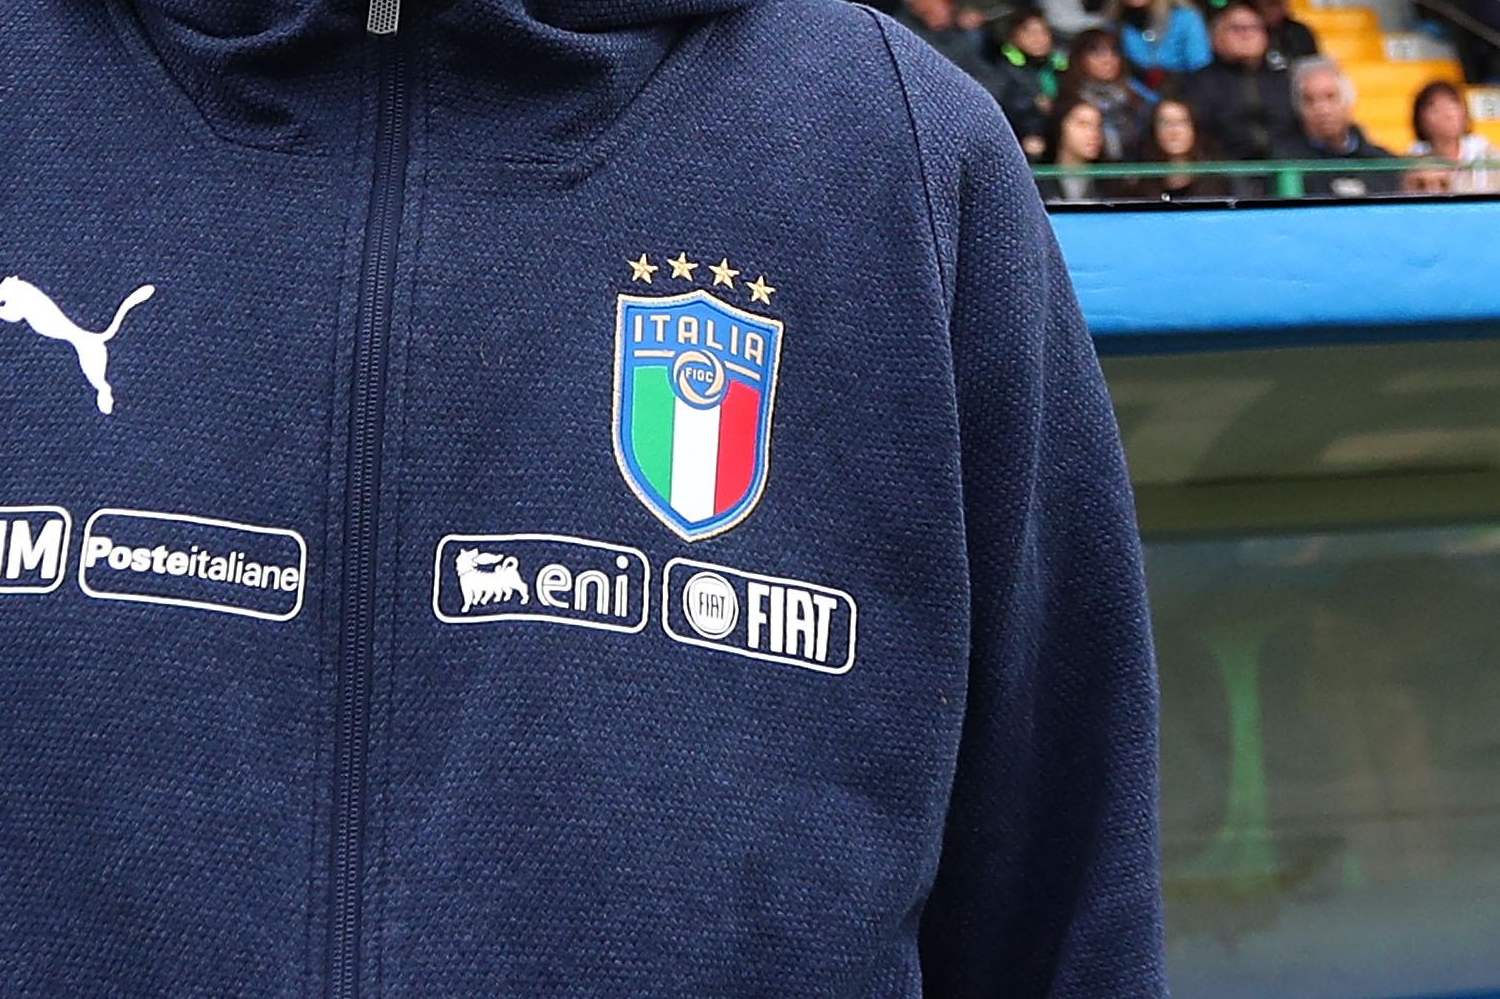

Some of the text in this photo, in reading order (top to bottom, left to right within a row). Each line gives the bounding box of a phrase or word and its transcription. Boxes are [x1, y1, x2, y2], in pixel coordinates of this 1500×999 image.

[633, 313, 765, 367] ITALIA
[84, 536, 300, 592] Posteitaliane
[535, 554, 629, 618] eni
[698, 591, 725, 620] FIAT
[746, 581, 838, 662] FIAT
